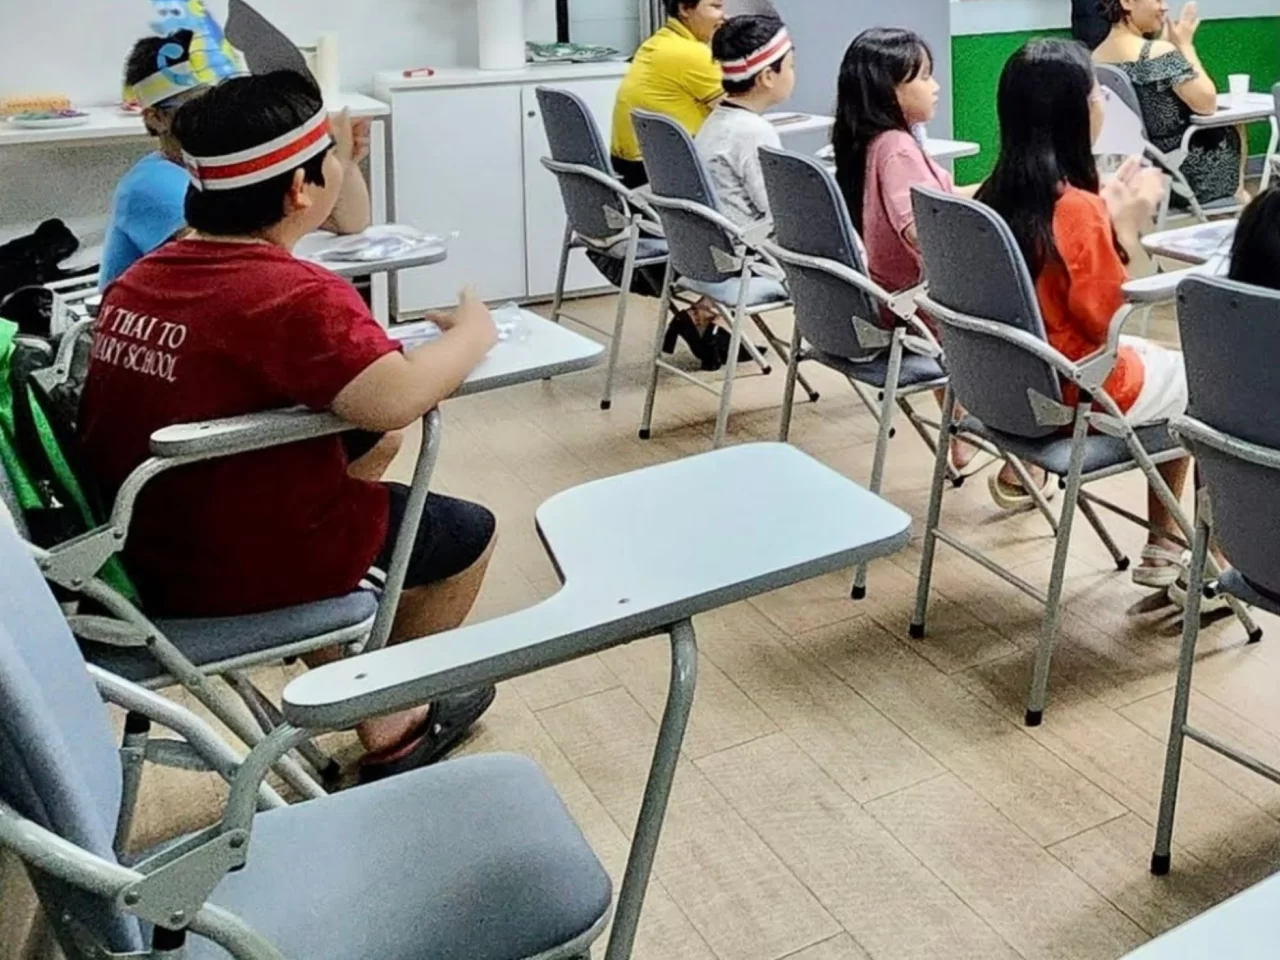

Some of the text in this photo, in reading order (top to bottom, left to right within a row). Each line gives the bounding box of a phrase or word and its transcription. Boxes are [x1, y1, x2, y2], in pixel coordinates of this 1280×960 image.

[111, 308, 159, 341] THAI
[157, 322, 187, 349] TO
[123, 344, 179, 382] SCHOOL
